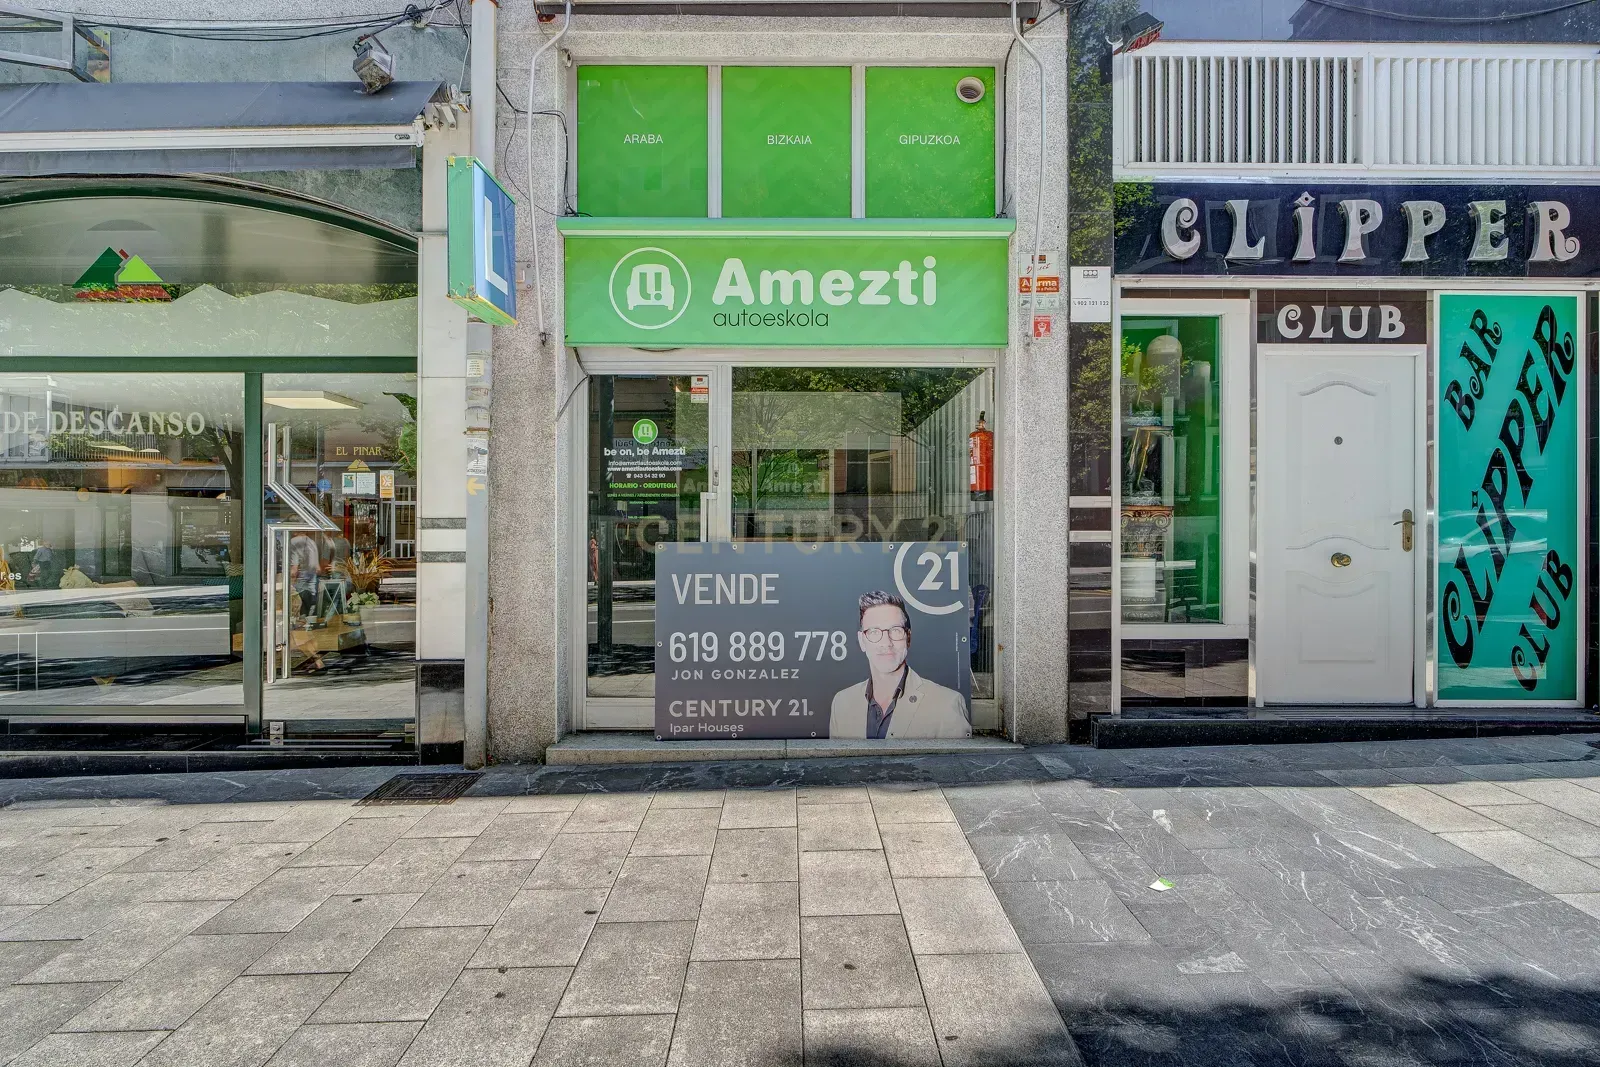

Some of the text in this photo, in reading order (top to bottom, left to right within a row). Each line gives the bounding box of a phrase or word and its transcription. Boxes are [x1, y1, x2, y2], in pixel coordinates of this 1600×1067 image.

[623, 134, 664, 145] ARABA
[766, 135, 813, 145] BIZKAIA
[898, 135, 961, 145] GIPUZKOA
[712, 255, 937, 306] Amezti
[713, 308, 830, 328] autoeskola
[1277, 303, 1406, 339] CLUB
[1444, 308, 1503, 432] BAR
[3, 410, 206, 436] DE DESCANSO
[336, 446, 382, 456] EL PINAR
[603, 446, 686, 457] be on, be Amezti
[671, 573, 780, 605] VENDE
[1510, 548, 1574, 692] CLUB
[669, 630, 848, 662] 619 889 778
[671, 668, 800, 681] JON GONZALEZ
[668, 699, 783, 718] CENTURY
[669, 722, 744, 736] Ipar Houses
